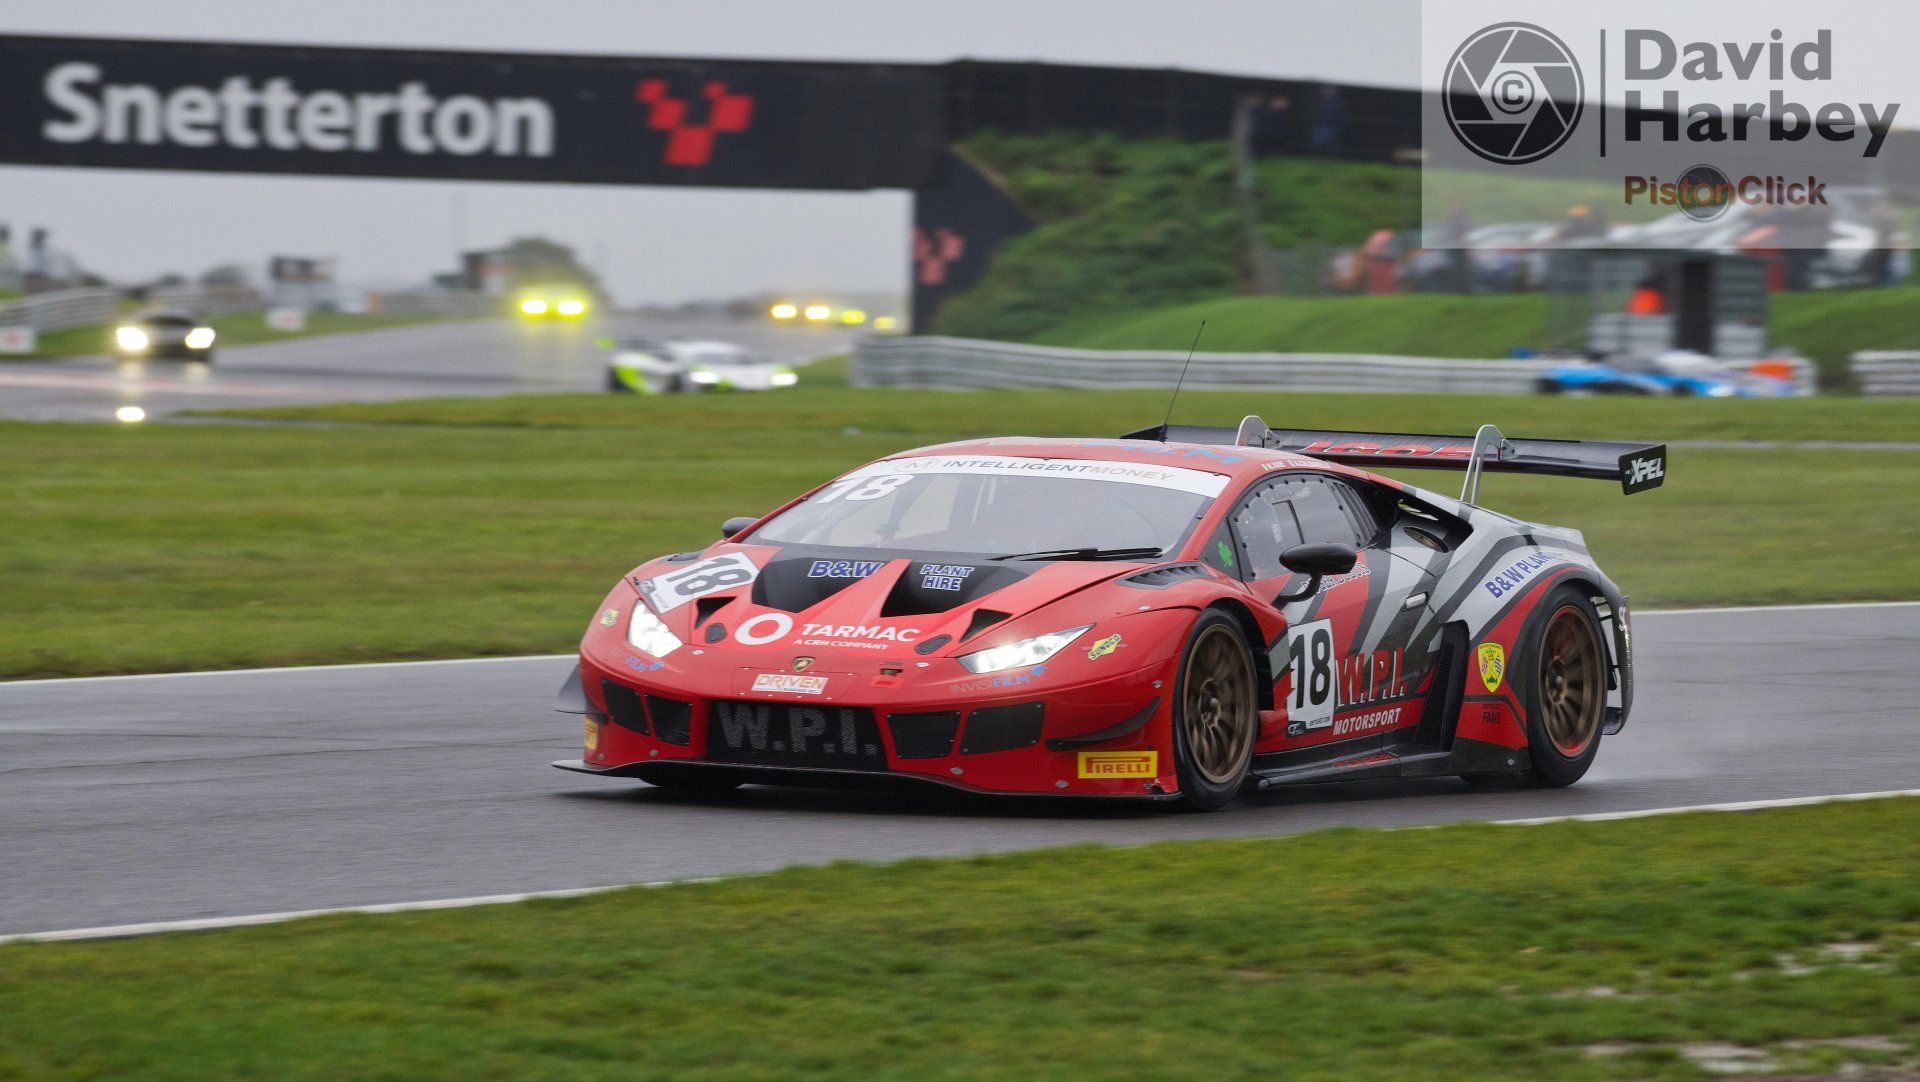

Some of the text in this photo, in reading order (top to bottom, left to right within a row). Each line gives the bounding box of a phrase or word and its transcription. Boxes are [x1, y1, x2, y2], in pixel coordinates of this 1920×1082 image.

[42, 62, 554, 158] Snetterton
[943, 460, 1175, 481] INTELLIGENTMONEY
[1629, 457, 1664, 485] XPEL
[816, 474, 914, 504] 18
[665, 557, 752, 596] 18
[808, 561, 886, 578] B&W
[919, 564, 975, 578] PLANT
[1484, 566, 1525, 599] B&W
[922, 576, 963, 591] HIRE
[801, 623, 921, 642] TARMAC
[832, 640, 890, 650] COMPANY
[1088, 634, 1122, 660] SUNOCO
[1290, 629, 1330, 709] 18
[1335, 646, 1408, 706] W.P.I.
[756, 675, 826, 690] DRIVEN
[716, 701, 878, 755] W.P.I.
[1333, 708, 1402, 735] MOTORSPORT
[1086, 756, 1151, 773] PIRELLI
